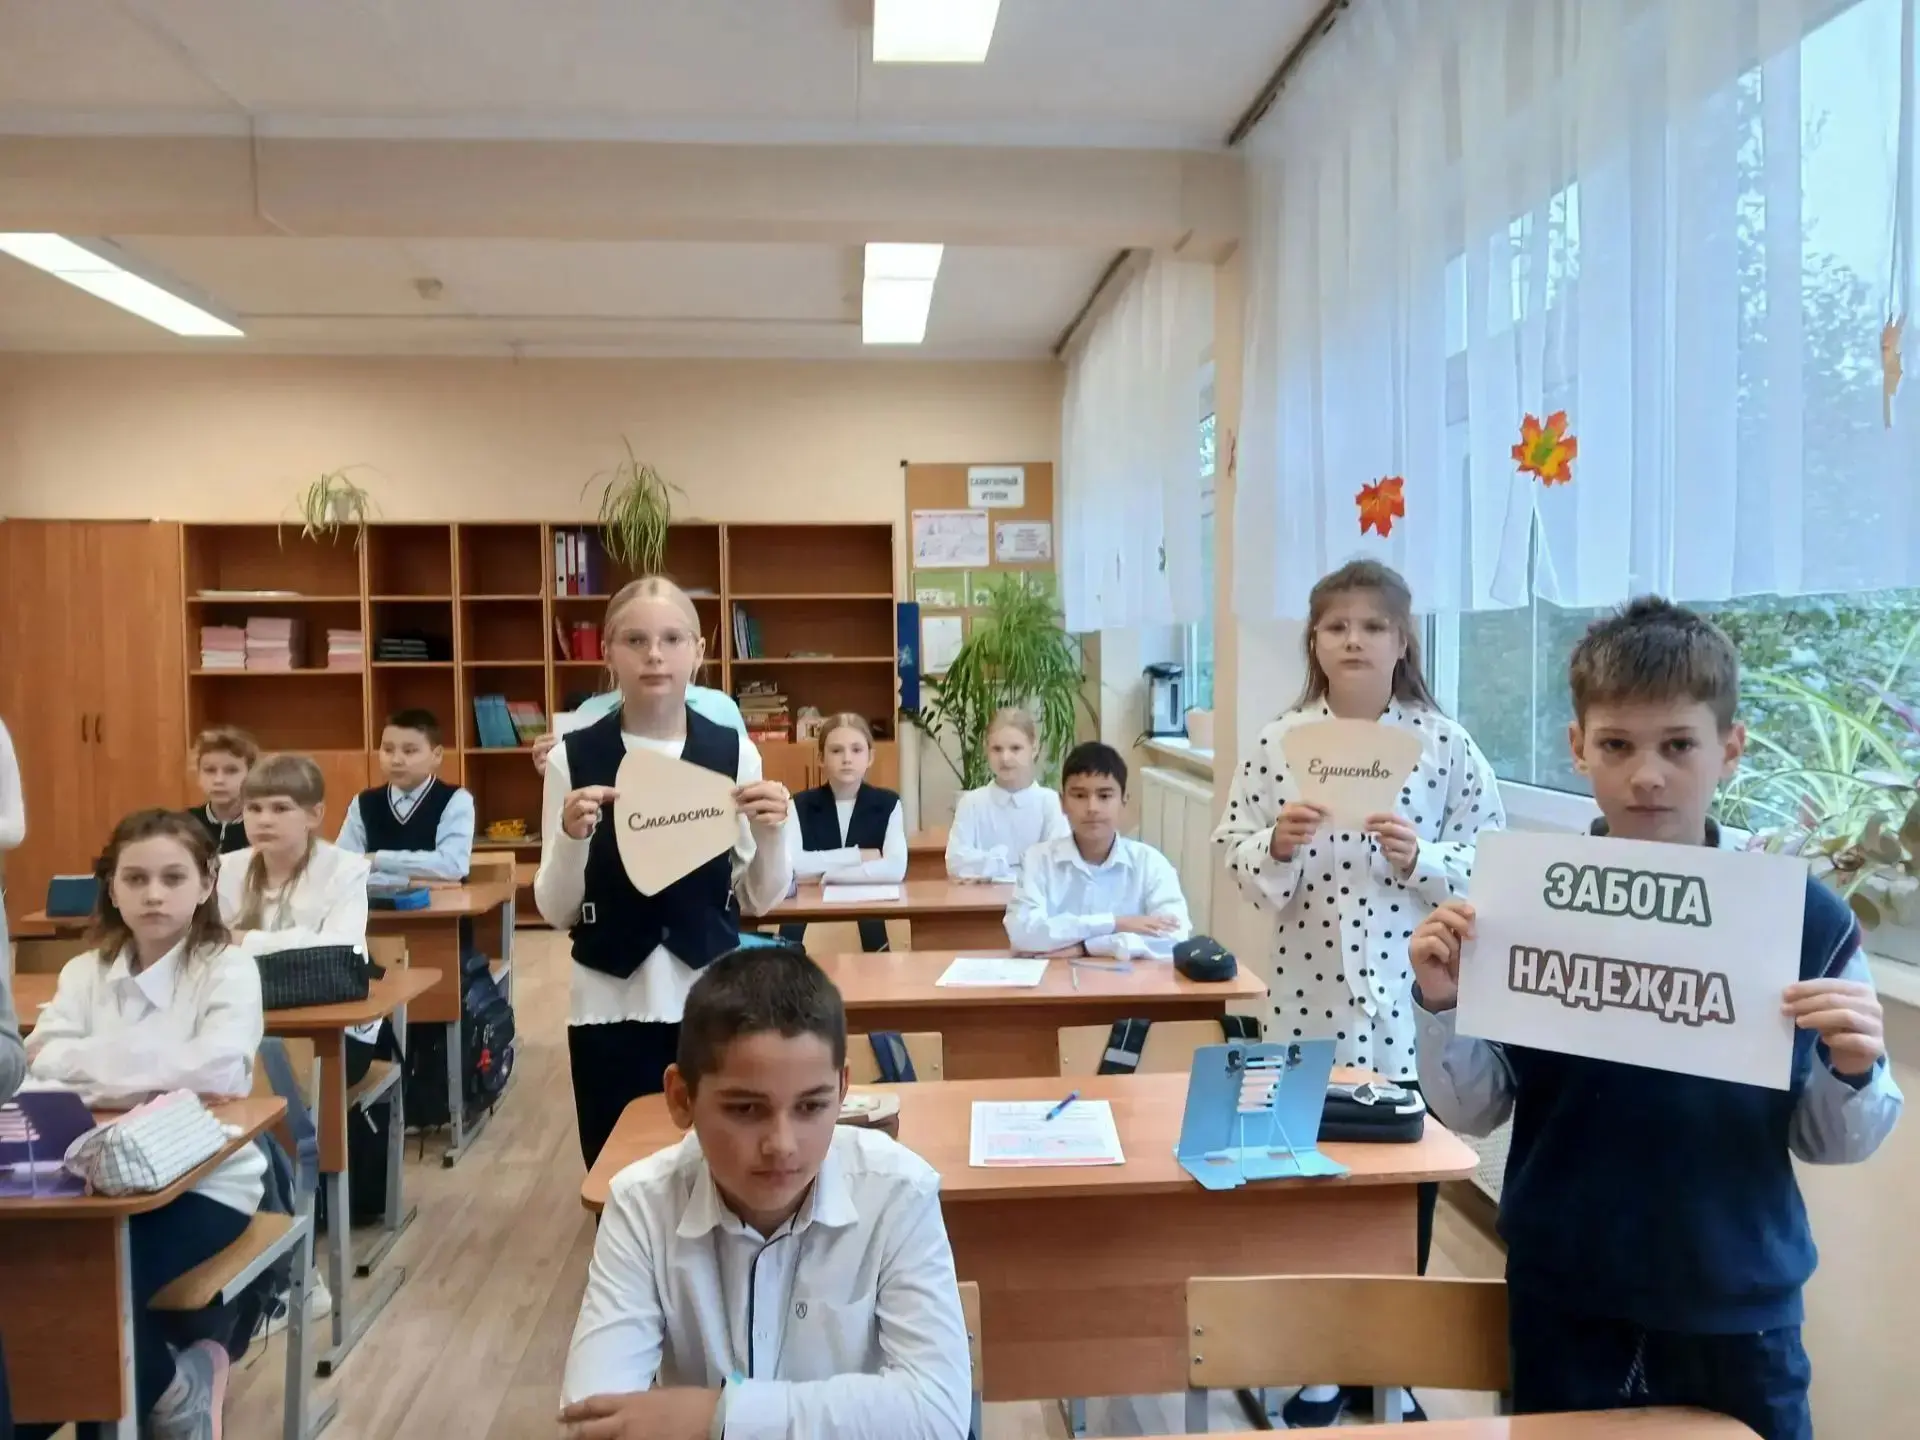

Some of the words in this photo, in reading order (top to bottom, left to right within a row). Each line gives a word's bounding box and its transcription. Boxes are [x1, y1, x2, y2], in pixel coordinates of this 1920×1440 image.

[1308, 758, 1392, 783] Единство
[628, 807, 724, 831] Смелость
[1543, 862, 1712, 927] ЗАБОТА
[1508, 945, 1735, 1027] НАДЕЖДА
